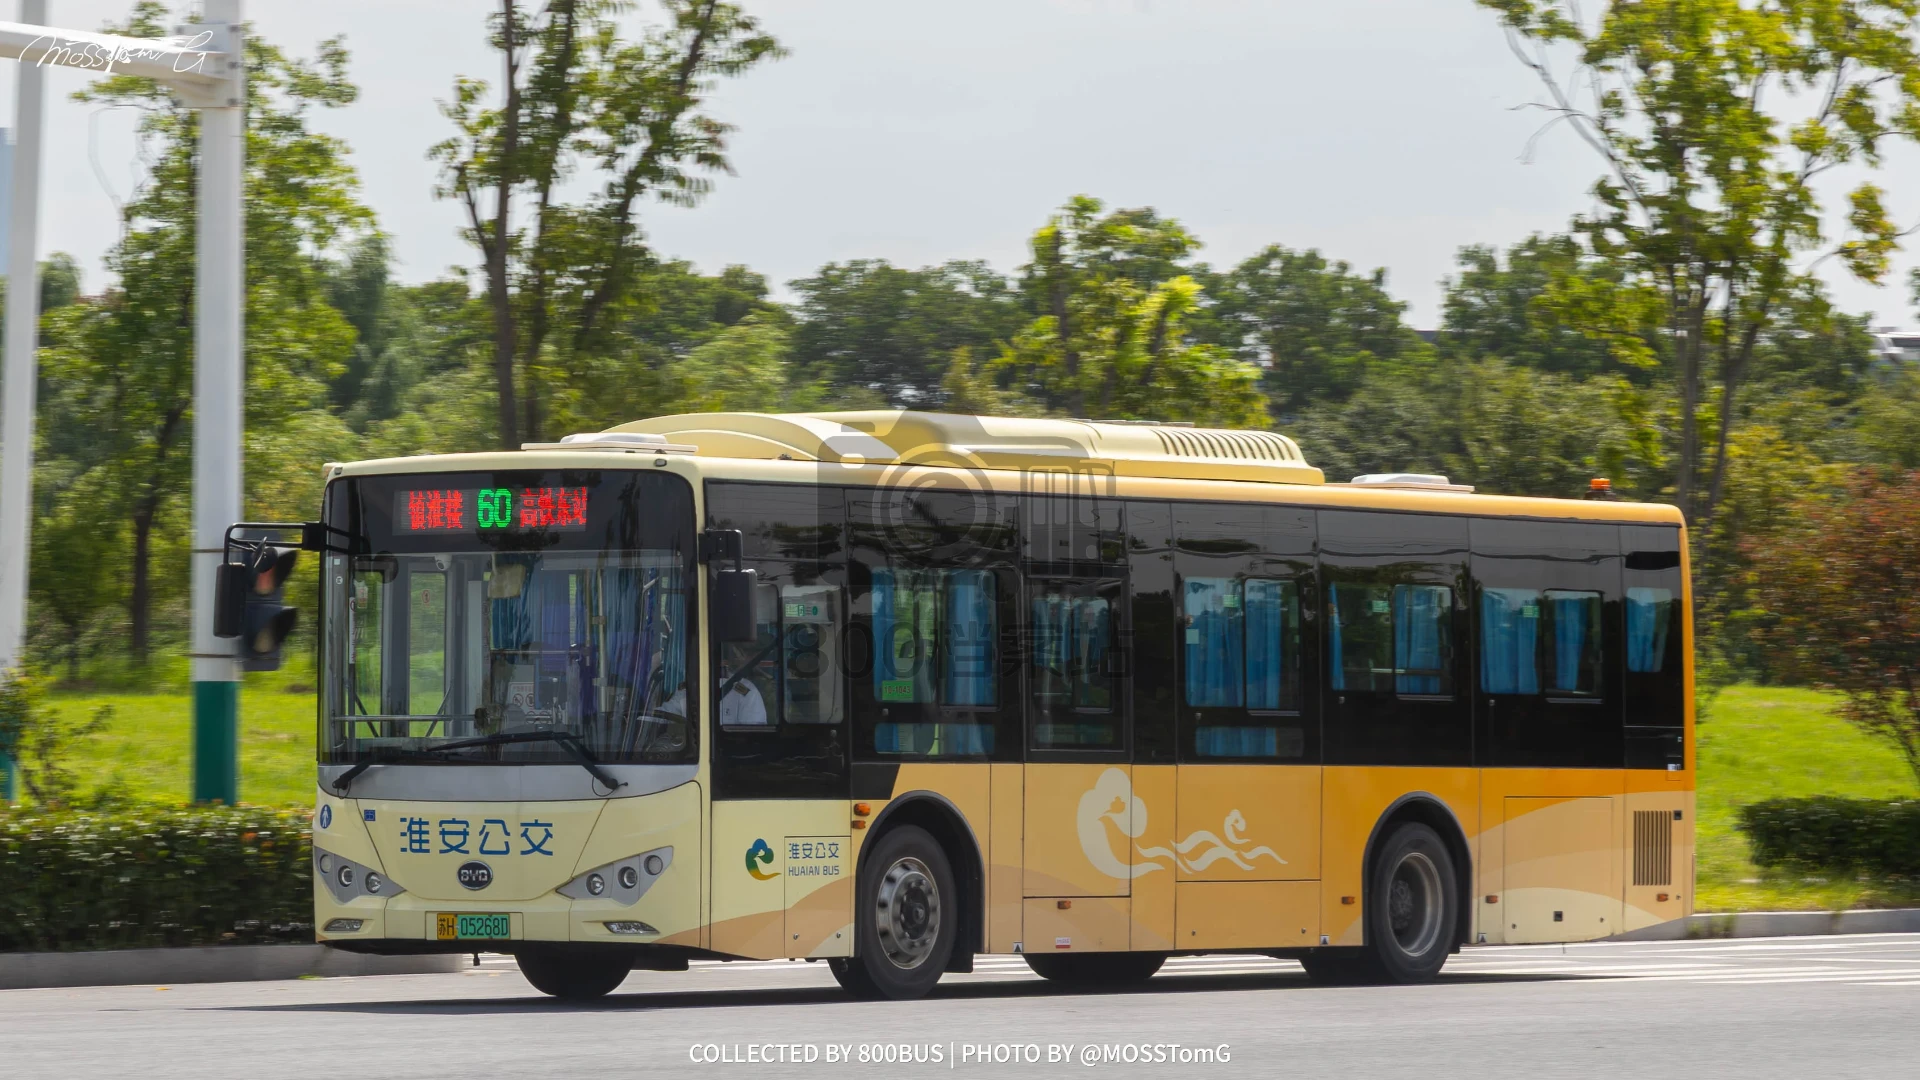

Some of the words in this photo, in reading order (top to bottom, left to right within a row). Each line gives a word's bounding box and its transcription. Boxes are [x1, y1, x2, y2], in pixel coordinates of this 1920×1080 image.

[477, 488, 512, 528] 60
[519, 486, 588, 528] 高铁东站
[399, 817, 554, 856] 淮安公交
[788, 842, 839, 860] 淮安公交
[460, 869, 488, 881] BYD
[788, 866, 820, 876] HUAIAN
[823, 865, 840, 876] BUS
[460, 917, 509, 936] 05268D
